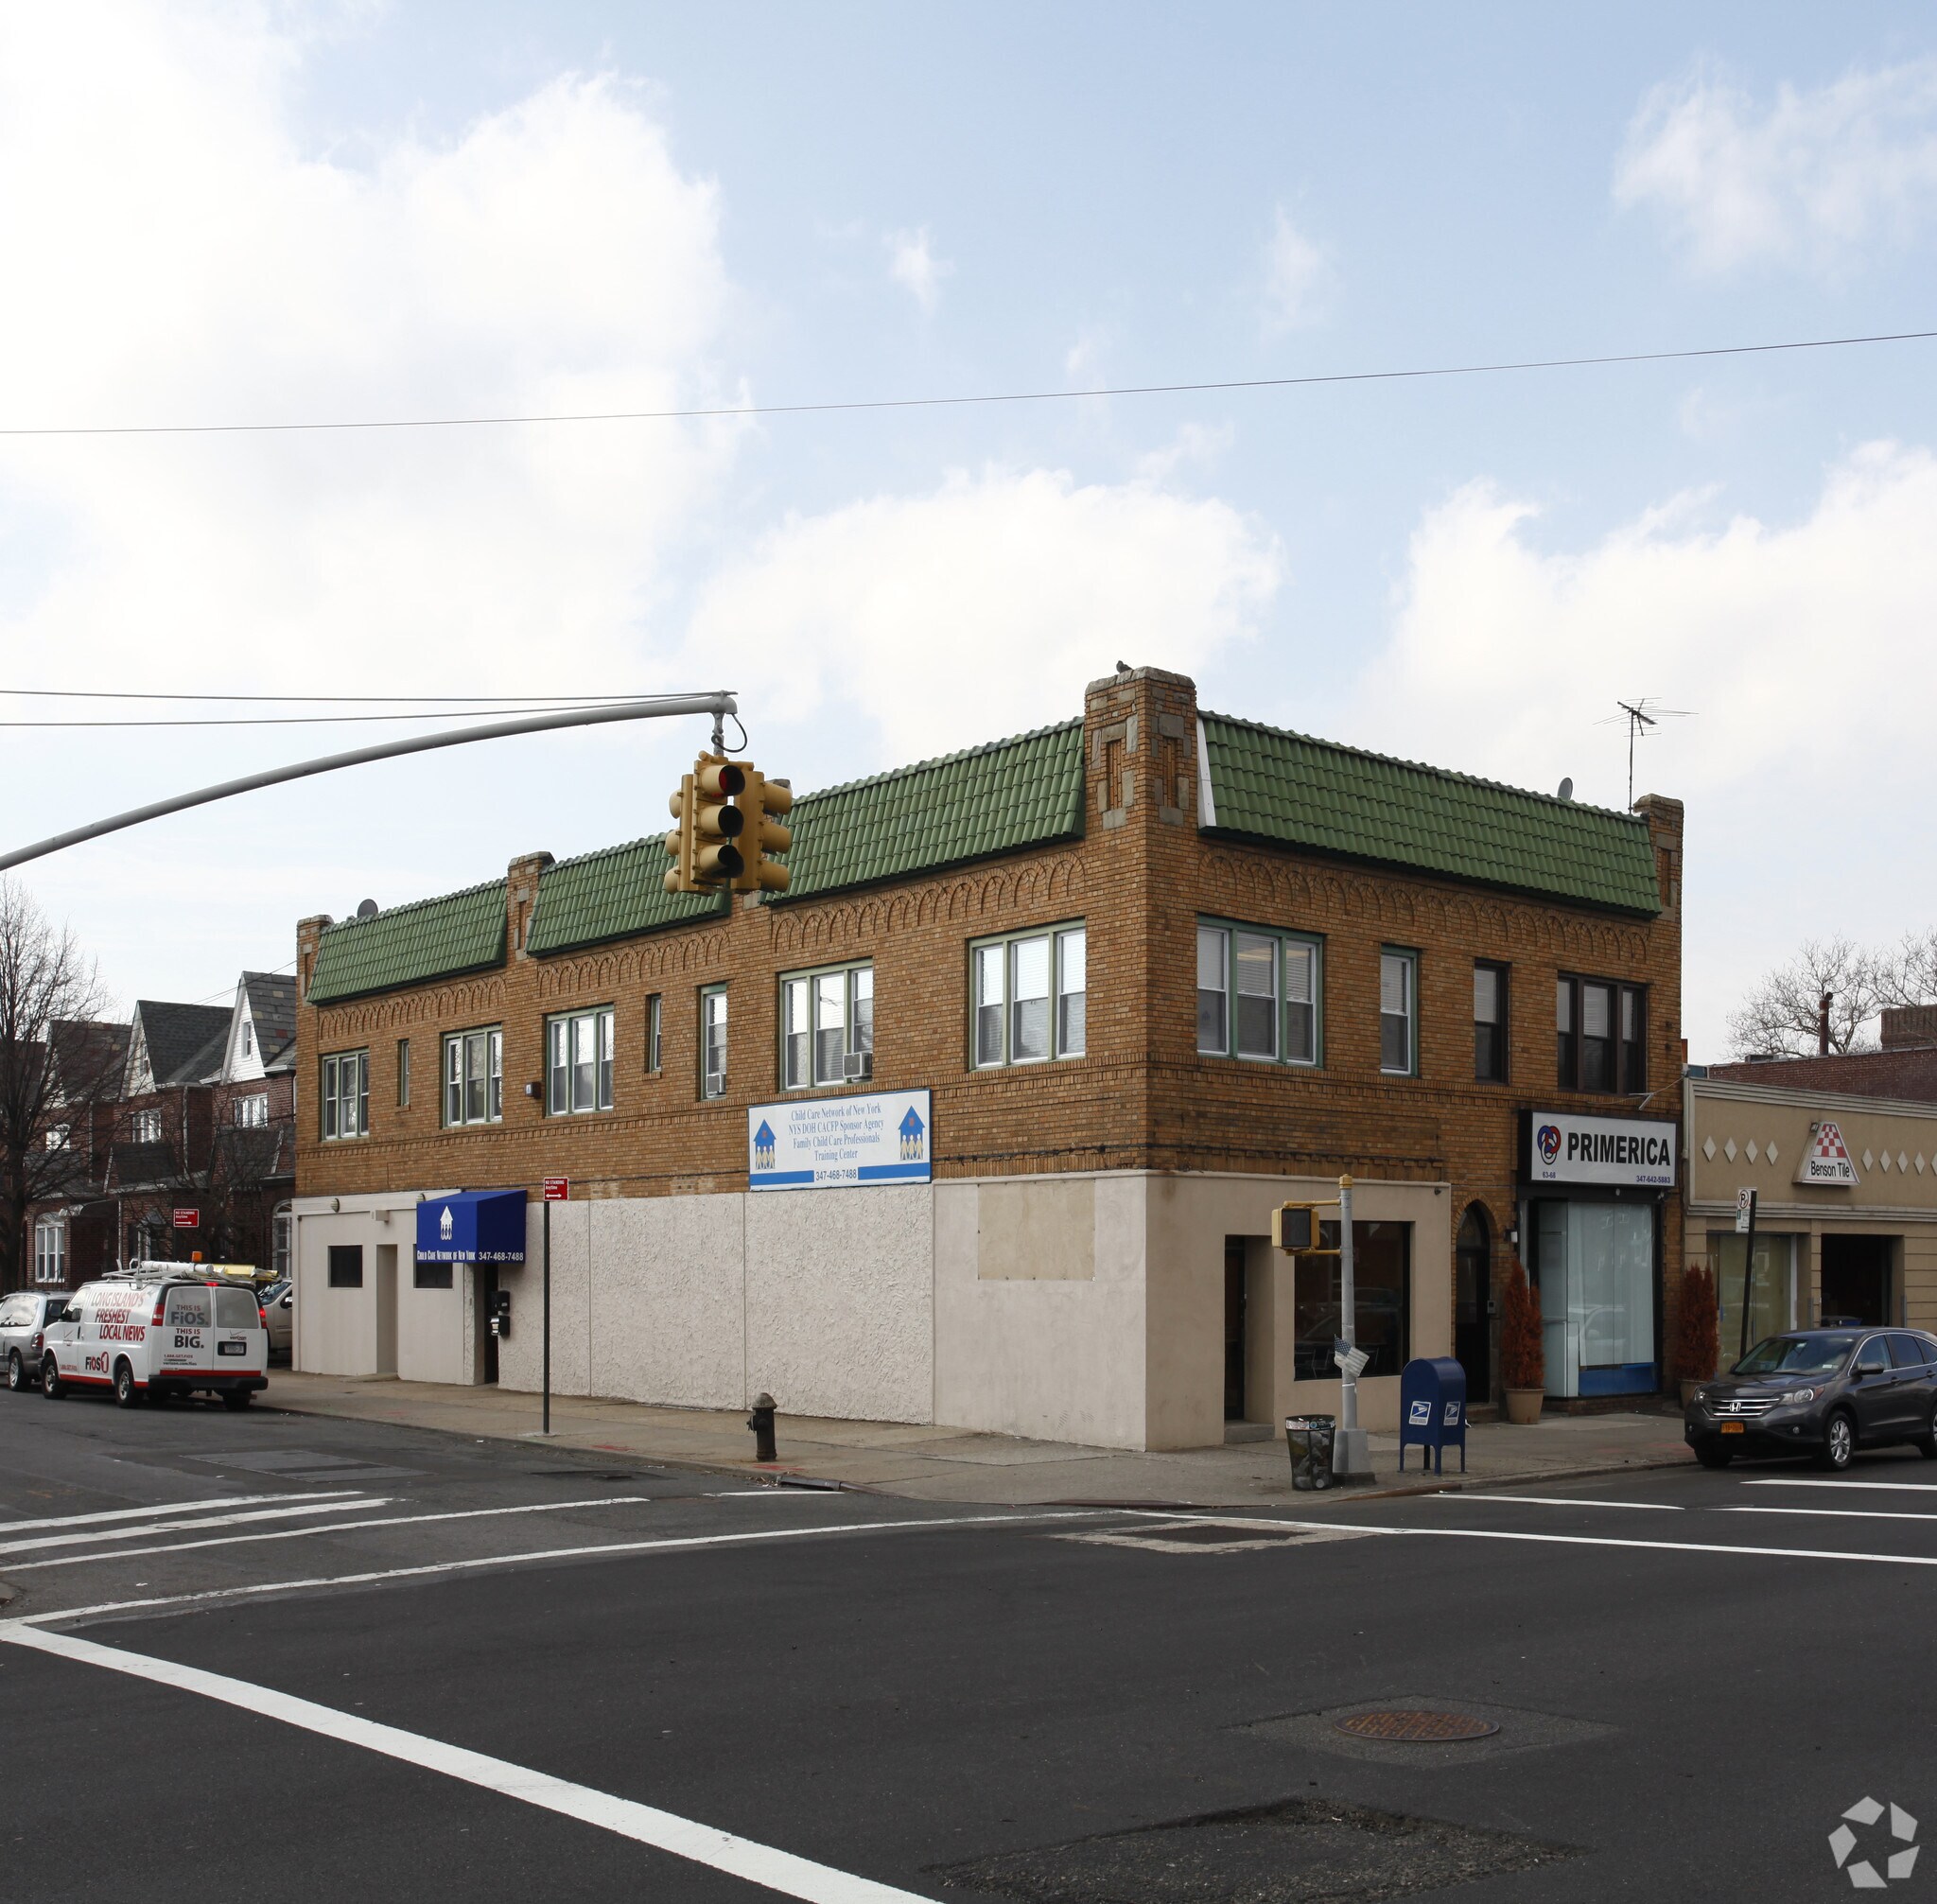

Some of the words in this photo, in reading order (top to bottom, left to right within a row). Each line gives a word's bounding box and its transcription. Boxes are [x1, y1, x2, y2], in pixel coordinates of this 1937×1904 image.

[791, 1109, 806, 1121] Child
[807, 1109, 820, 1120] Care
[821, 1106, 846, 1118] Network
[846, 1105, 851, 1115] of
[853, 1105, 864, 1115] New
[866, 1103, 881, 1114] York
[789, 1124, 801, 1135] NYS
[802, 1122, 815, 1134] DOH
[817, 1120, 839, 1133] CACFP
[840, 1120, 862, 1133] Sponsor
[864, 1118, 883, 1131] Agency
[794, 1137, 811, 1150] Family
[813, 1136, 828, 1147] Child
[829, 1135, 843, 1145] Care
[844, 1132, 880, 1144] Professionals
[814, 1149, 838, 1162] Training
[839, 1148, 858, 1160] Center
[1568, 1132, 1670, 1166] PRIMERICA
[816, 1169, 857, 1180] 347-468-7488
[1811, 1161, 1836, 1177] Benson
[1838, 1162, 1850, 1178] Tile
[1636, 1175, 1671, 1183] 347-642-5883
[479, 1251, 524, 1261] 347-468-7488
[91, 1292, 113, 1306] LONG
[111, 1292, 146, 1307] ISLAND'S
[96, 1308, 131, 1324] FRESHEST
[171, 1312, 208, 1324] FiOS.
[99, 1324, 122, 1339] LOCAL
[123, 1325, 146, 1341] NEWS
[174, 1336, 204, 1349] BIG.
